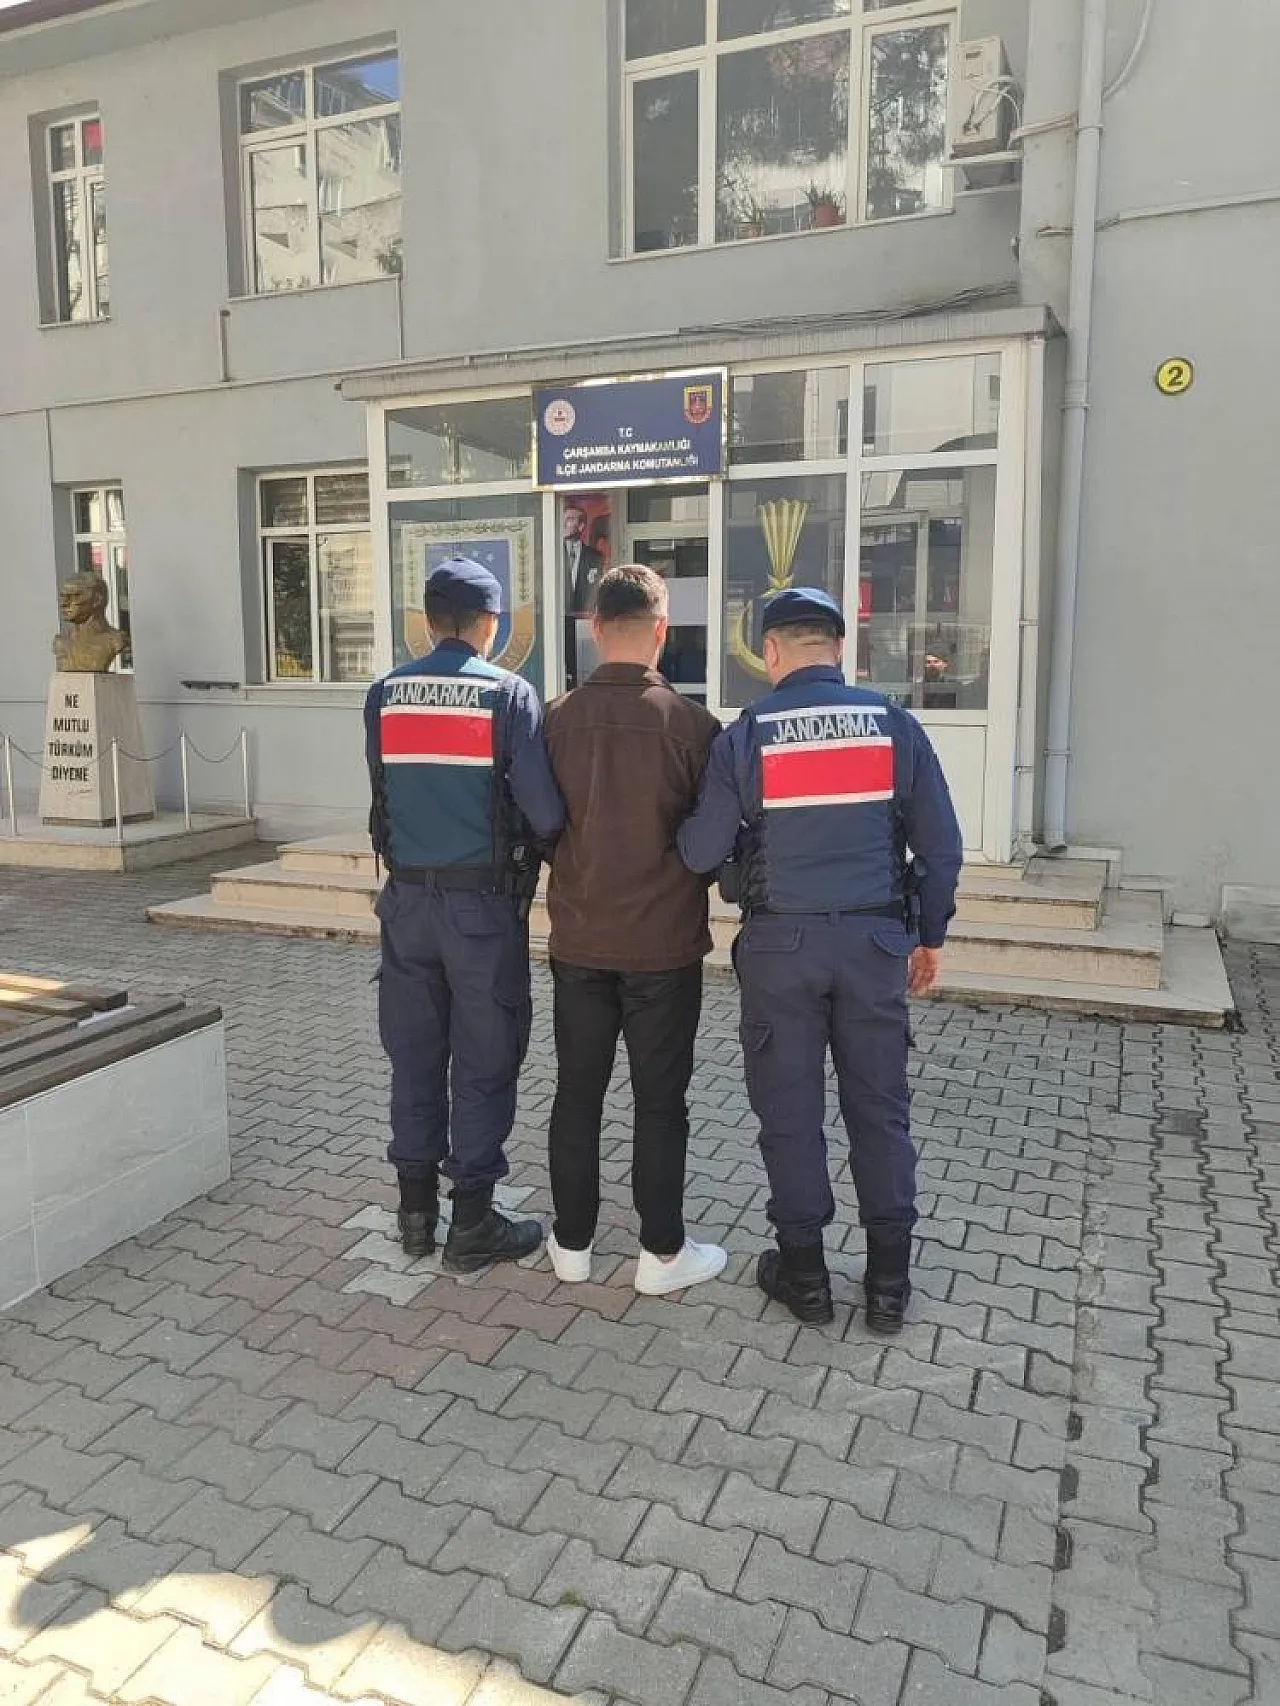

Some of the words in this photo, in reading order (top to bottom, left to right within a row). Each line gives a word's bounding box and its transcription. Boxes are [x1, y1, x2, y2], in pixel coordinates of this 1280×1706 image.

[1168, 366, 1183, 387] 2
[578, 460, 630, 473] JANDARMA
[64, 693, 79, 709] NE
[386, 681, 480, 706] JANDARMA
[53, 718, 89, 732] MUTLU
[773, 712, 881, 743] JANDARMA
